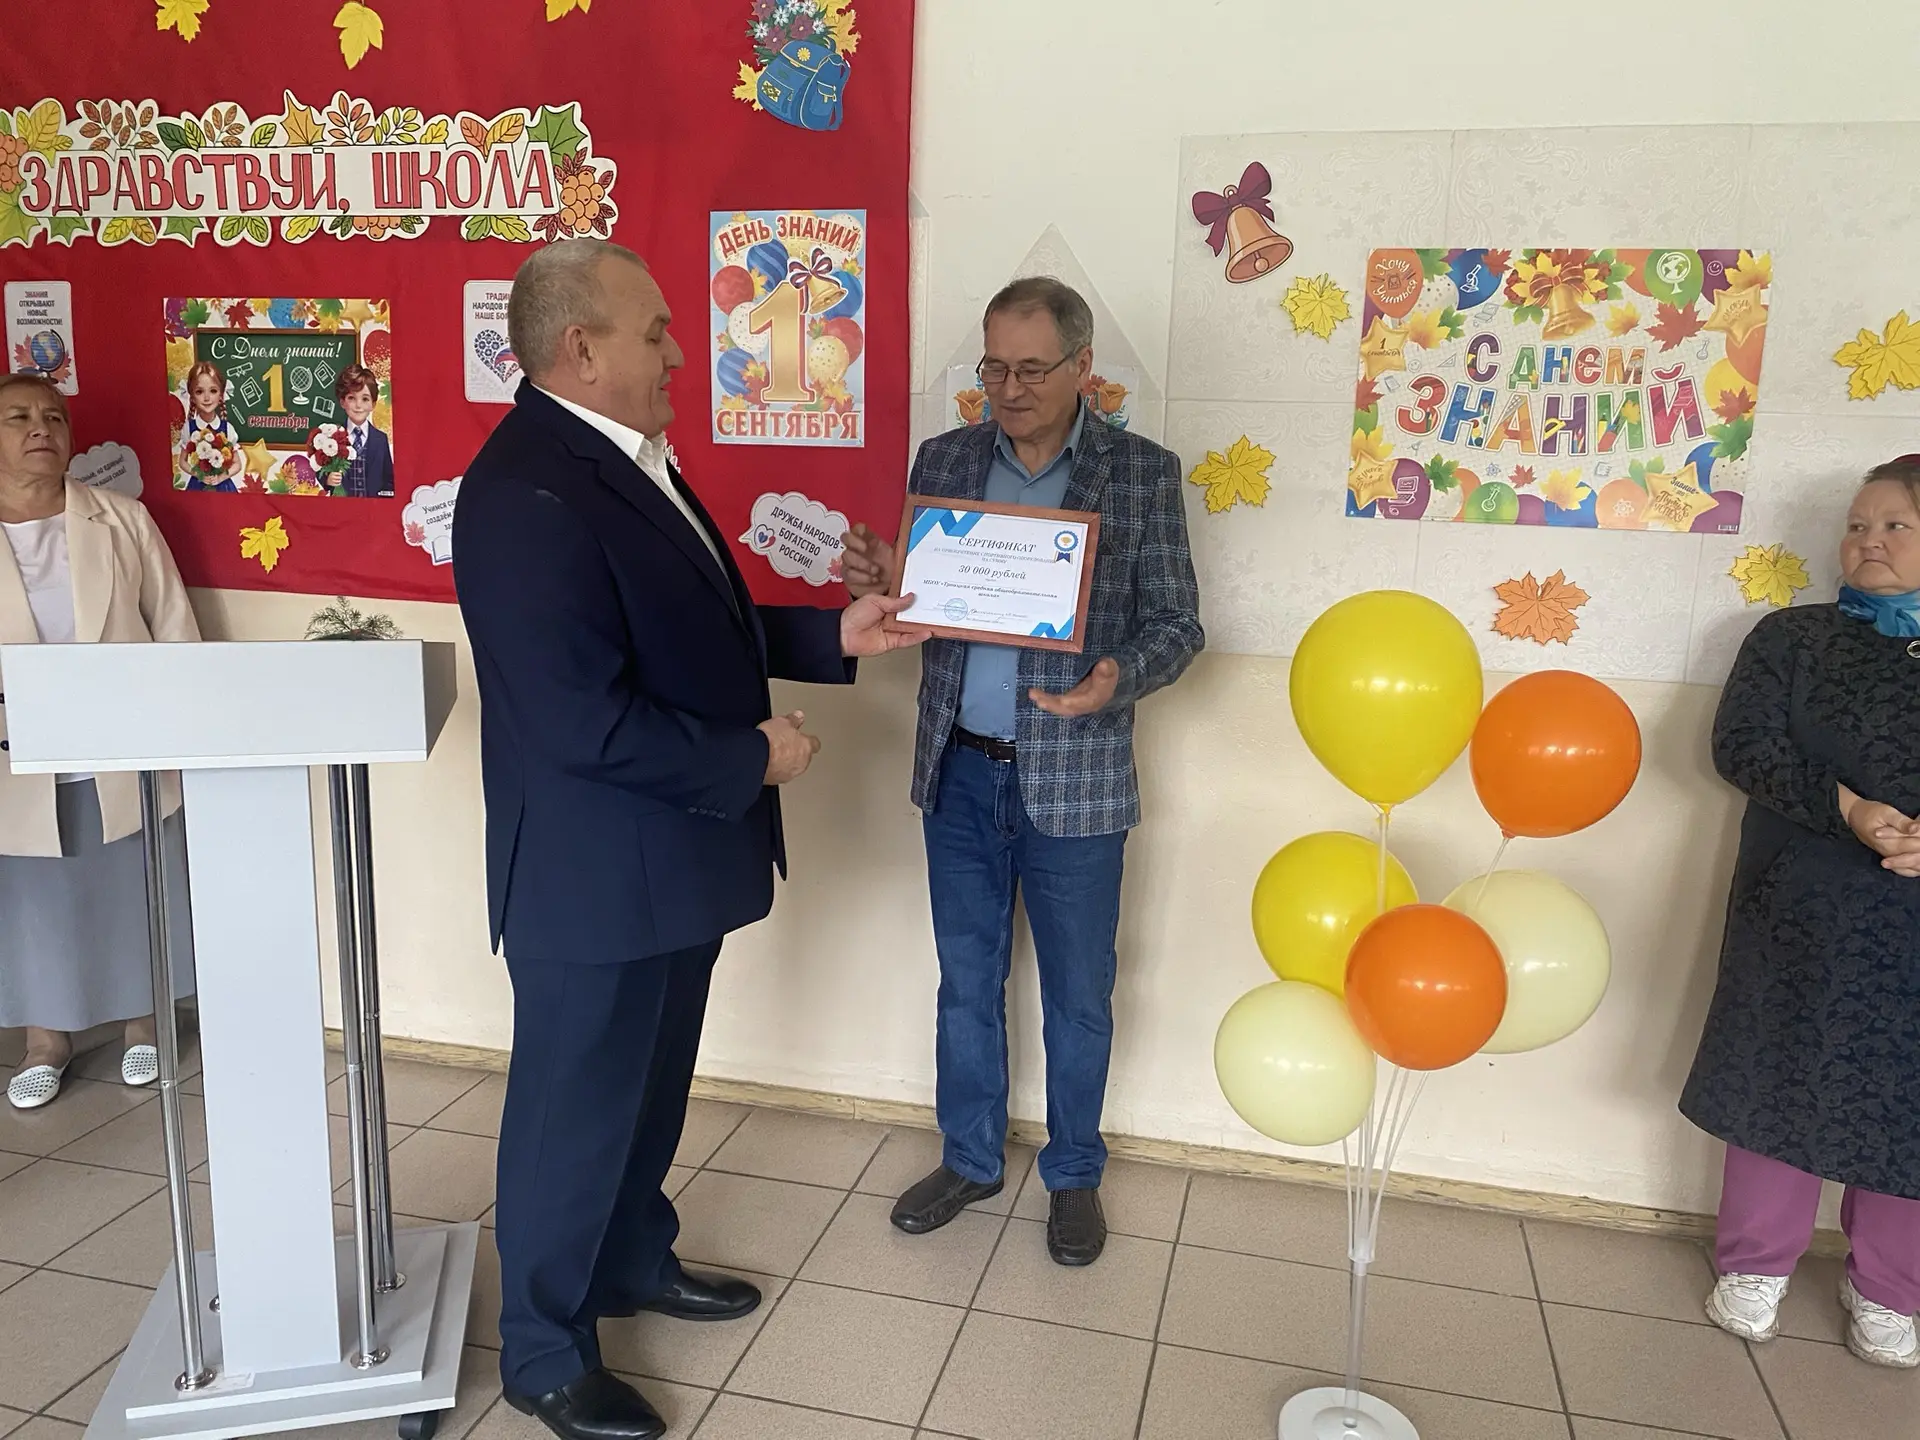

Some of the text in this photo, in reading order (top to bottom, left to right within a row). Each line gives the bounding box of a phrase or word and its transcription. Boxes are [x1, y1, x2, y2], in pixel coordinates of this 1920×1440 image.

[21, 147, 555, 217] ЗДРАВСТВУЙ, ШКОЛА
[718, 216, 861, 258] ДЕНЬ ЗНАНИЙ
[19, 300, 55, 308] ОТКРЫВАЮТ
[27, 309, 48, 317] НОВЫЕ
[472, 302, 503, 311] НАРОДОВ
[475, 311, 495, 320] НАШЕ
[211, 337, 226, 359] С
[283, 341, 343, 365] знаний!
[749, 281, 816, 403] 1
[1379, 337, 1387, 350] 1
[1464, 331, 1501, 384] С
[262, 363, 287, 413] 1
[248, 412, 309, 432] сентября
[1396, 362, 1707, 456] ЗНАНИЙ
[716, 409, 860, 440] СЕНТЯБРЯ
[422, 501, 447, 514] Учимся
[770, 506, 804, 530] ДРУЖБА
[803, 524, 841, 550] НАРОДОВ
[778, 527, 821, 556] БОГАТСТВО
[779, 543, 813, 569] РОССИИ!
[958, 537, 1037, 553] СЕРТИФИКАТ
[958, 564, 1027, 580] 30 000 рублей
